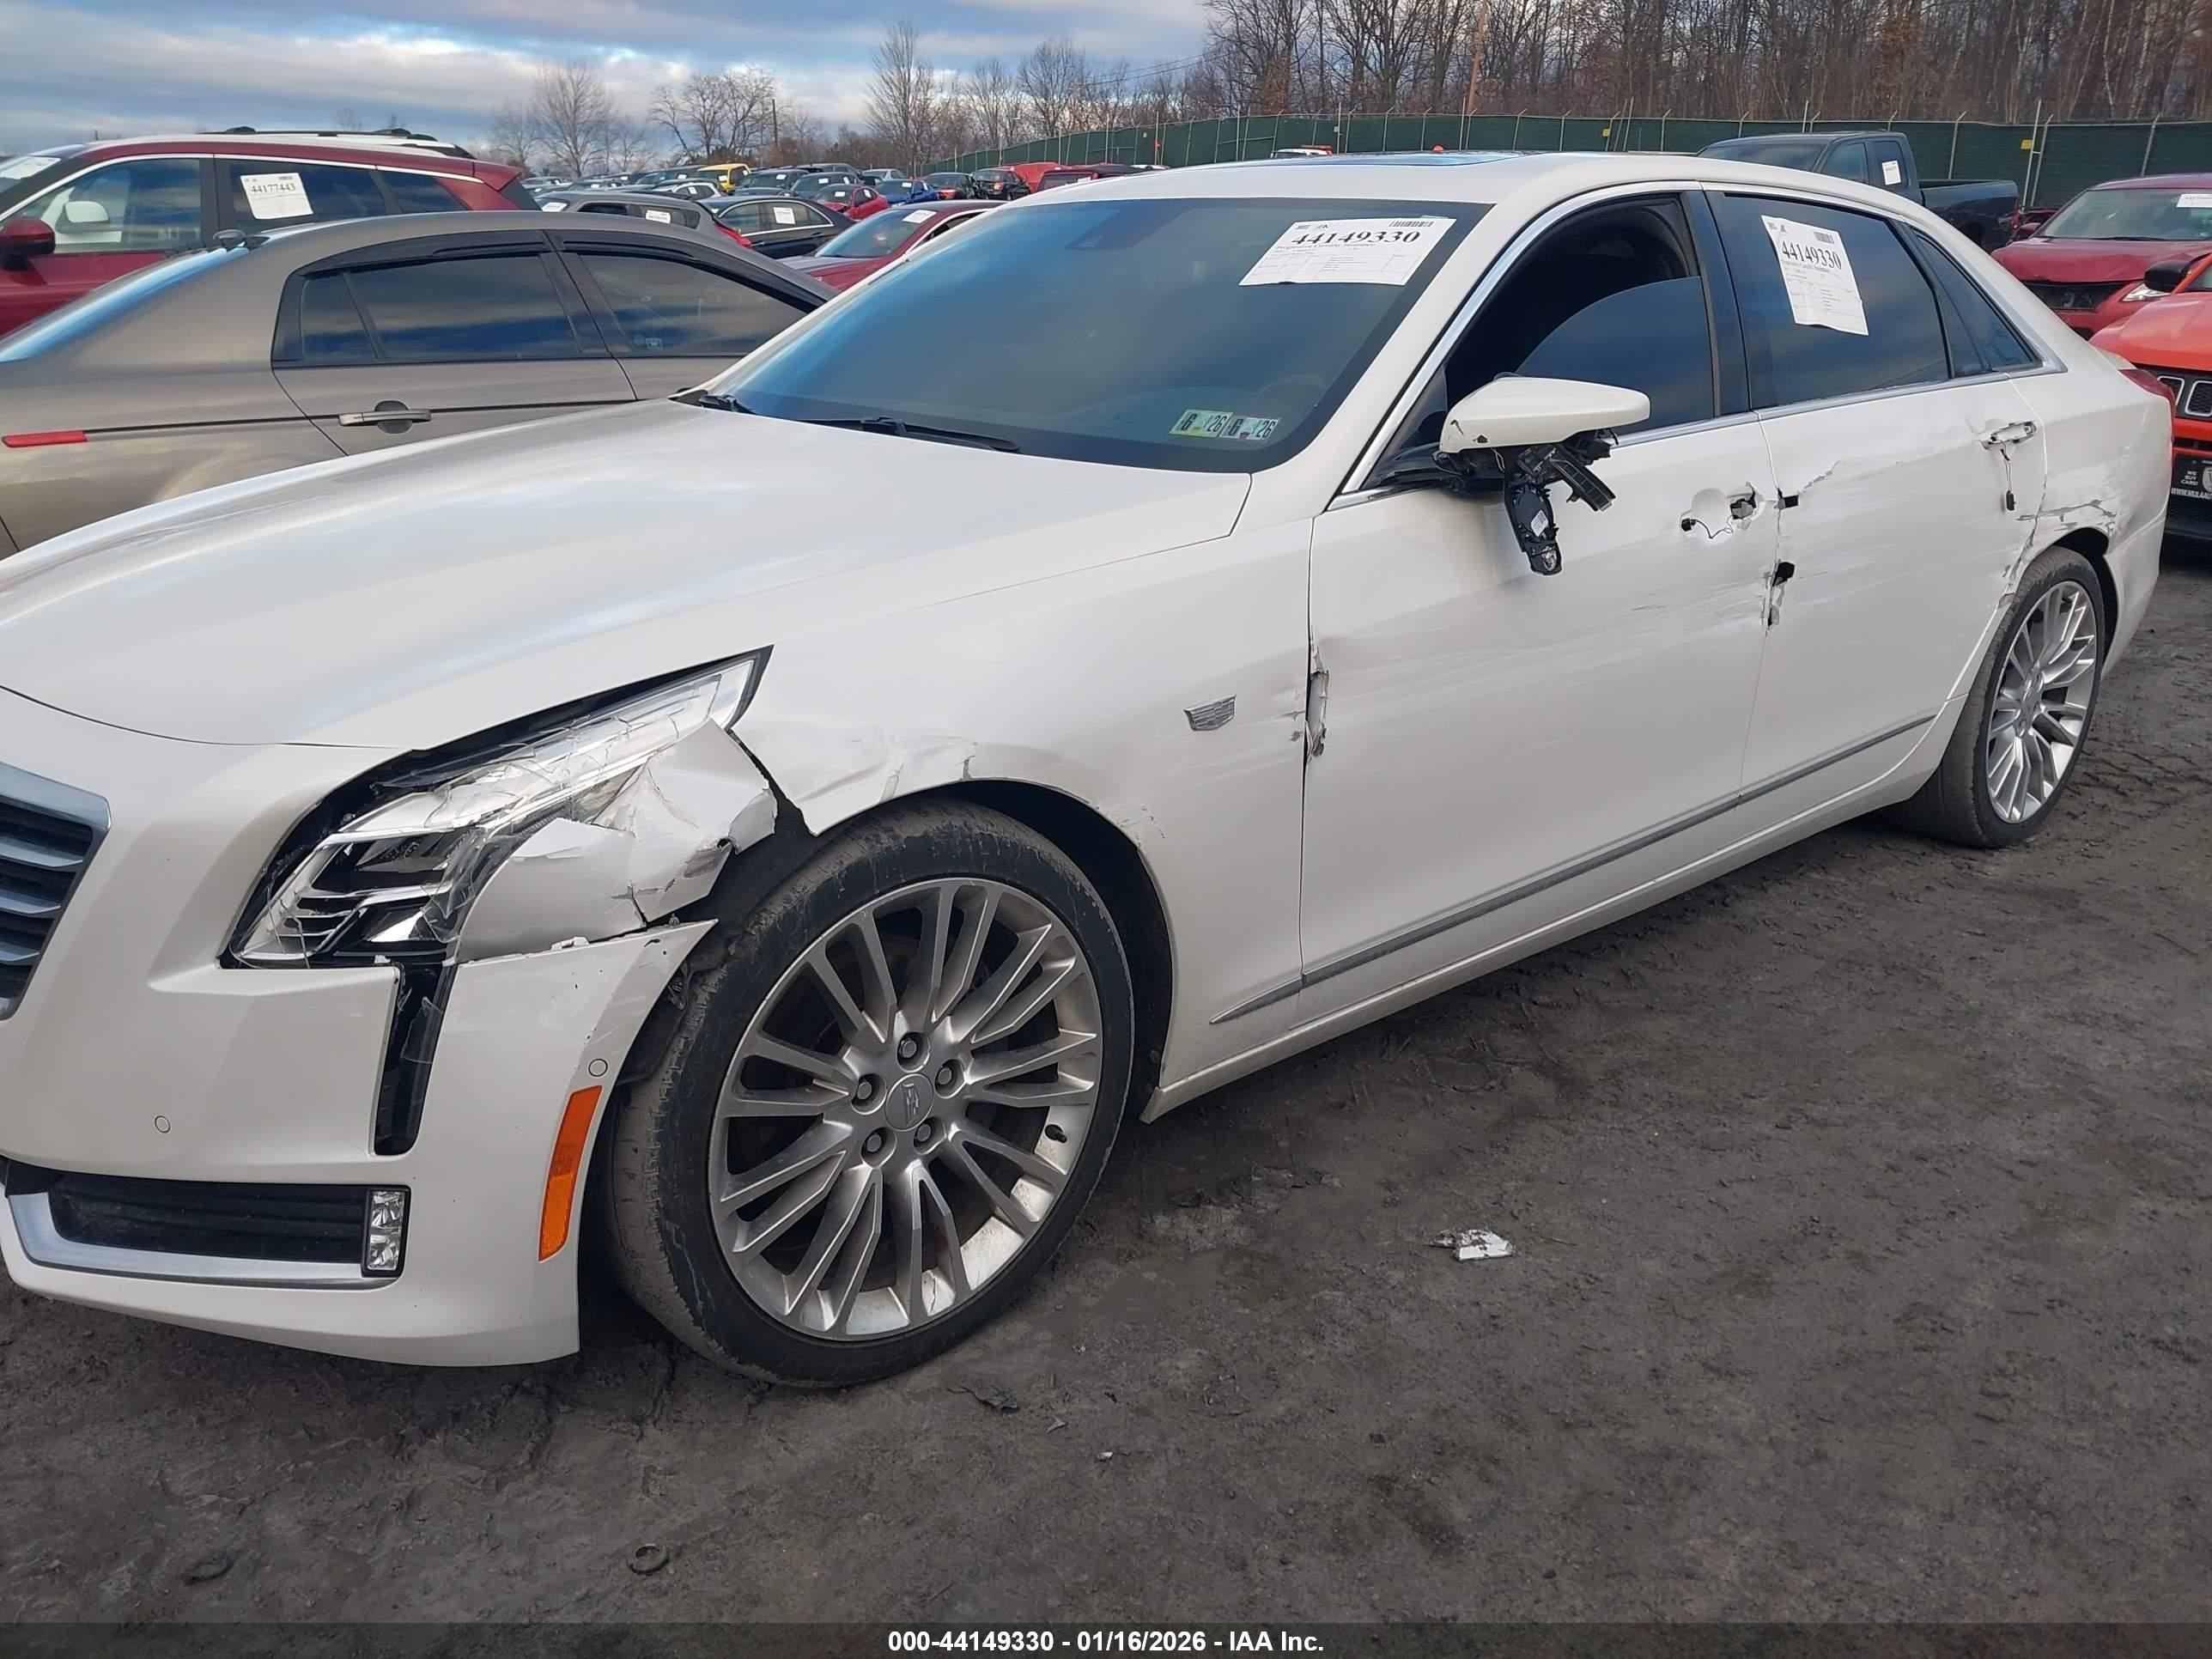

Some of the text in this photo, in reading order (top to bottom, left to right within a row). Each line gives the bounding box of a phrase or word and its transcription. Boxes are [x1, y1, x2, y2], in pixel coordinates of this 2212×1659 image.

[251, 183, 296, 192] 44177443
[1291, 231, 1420, 245] 44149330
[1782, 240, 1842, 270] 44149330
